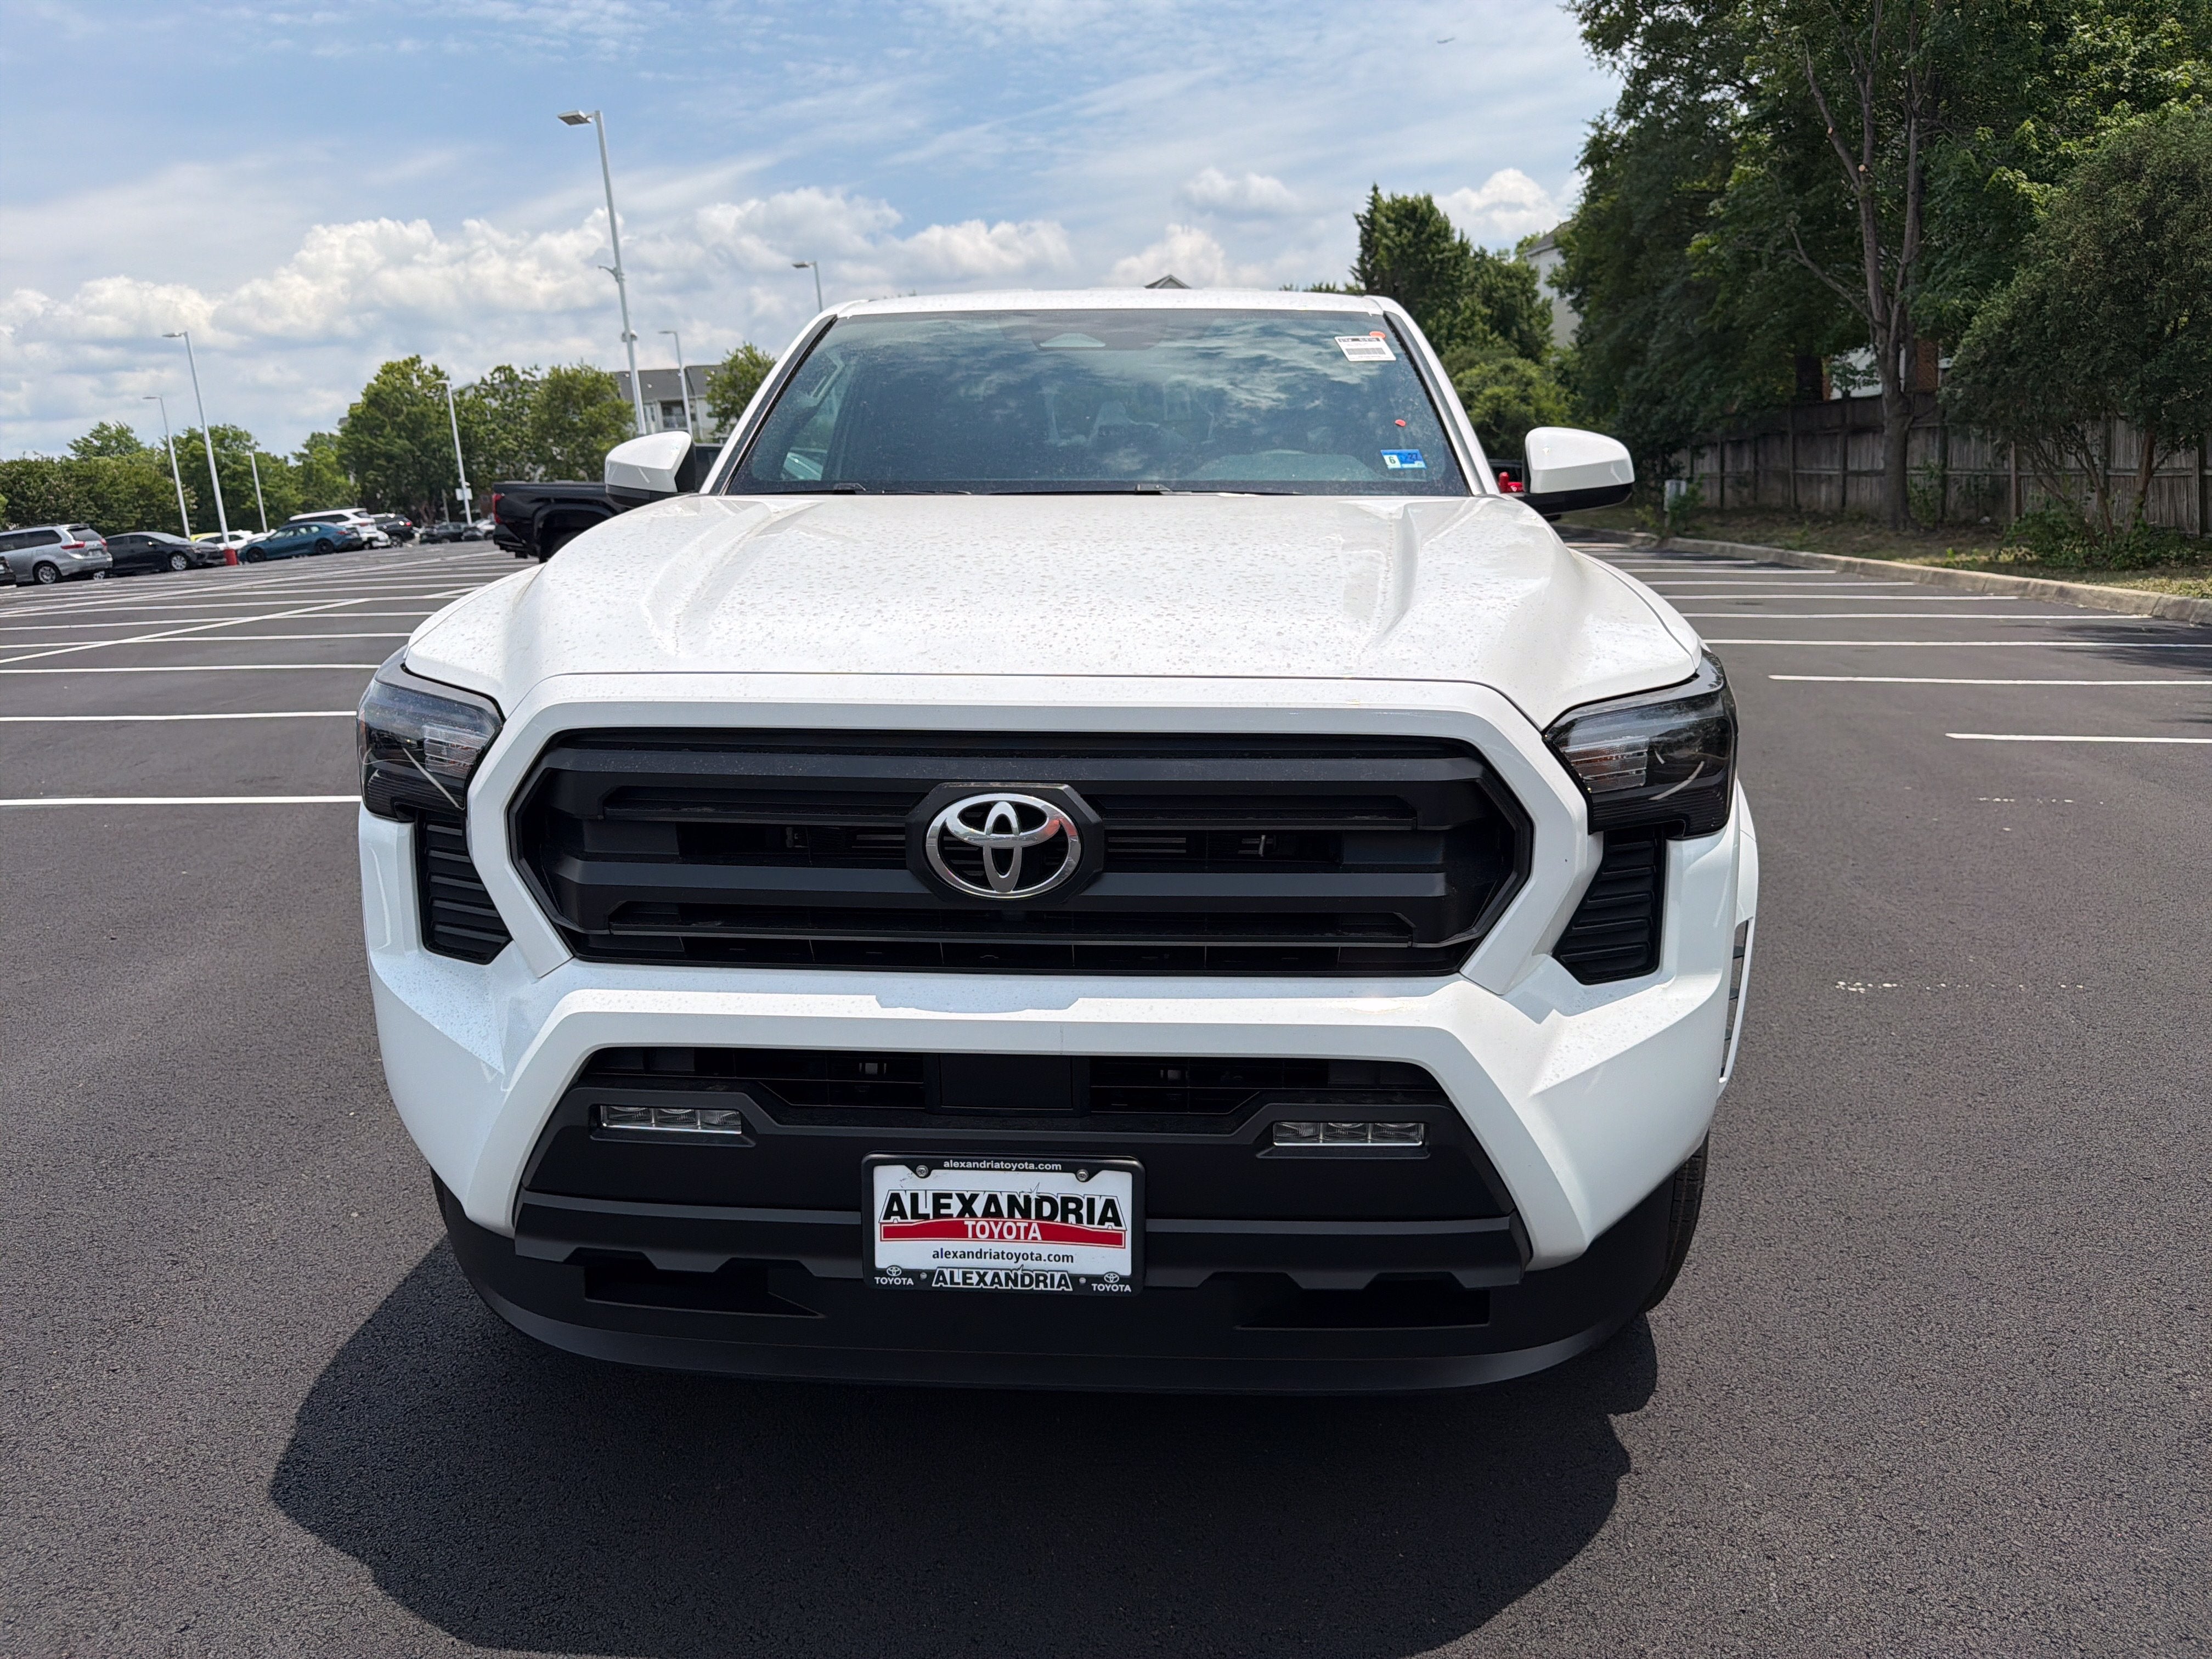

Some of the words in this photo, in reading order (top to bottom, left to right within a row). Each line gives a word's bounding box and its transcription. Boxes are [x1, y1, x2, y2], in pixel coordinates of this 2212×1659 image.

[1389, 456, 1396, 464] 6
[943, 1159, 1062, 1171] alexandriatoyota.com
[881, 1190, 1125, 1229] ALEXANDRIA
[964, 1220, 1042, 1240] TOYOTA
[932, 1248, 1074, 1263] alexandriatoyota.com
[874, 1277, 914, 1286] TOYOTA
[932, 1268, 1073, 1291] ALEXANDRIA
[1092, 1283, 1132, 1293] TOYOTA
